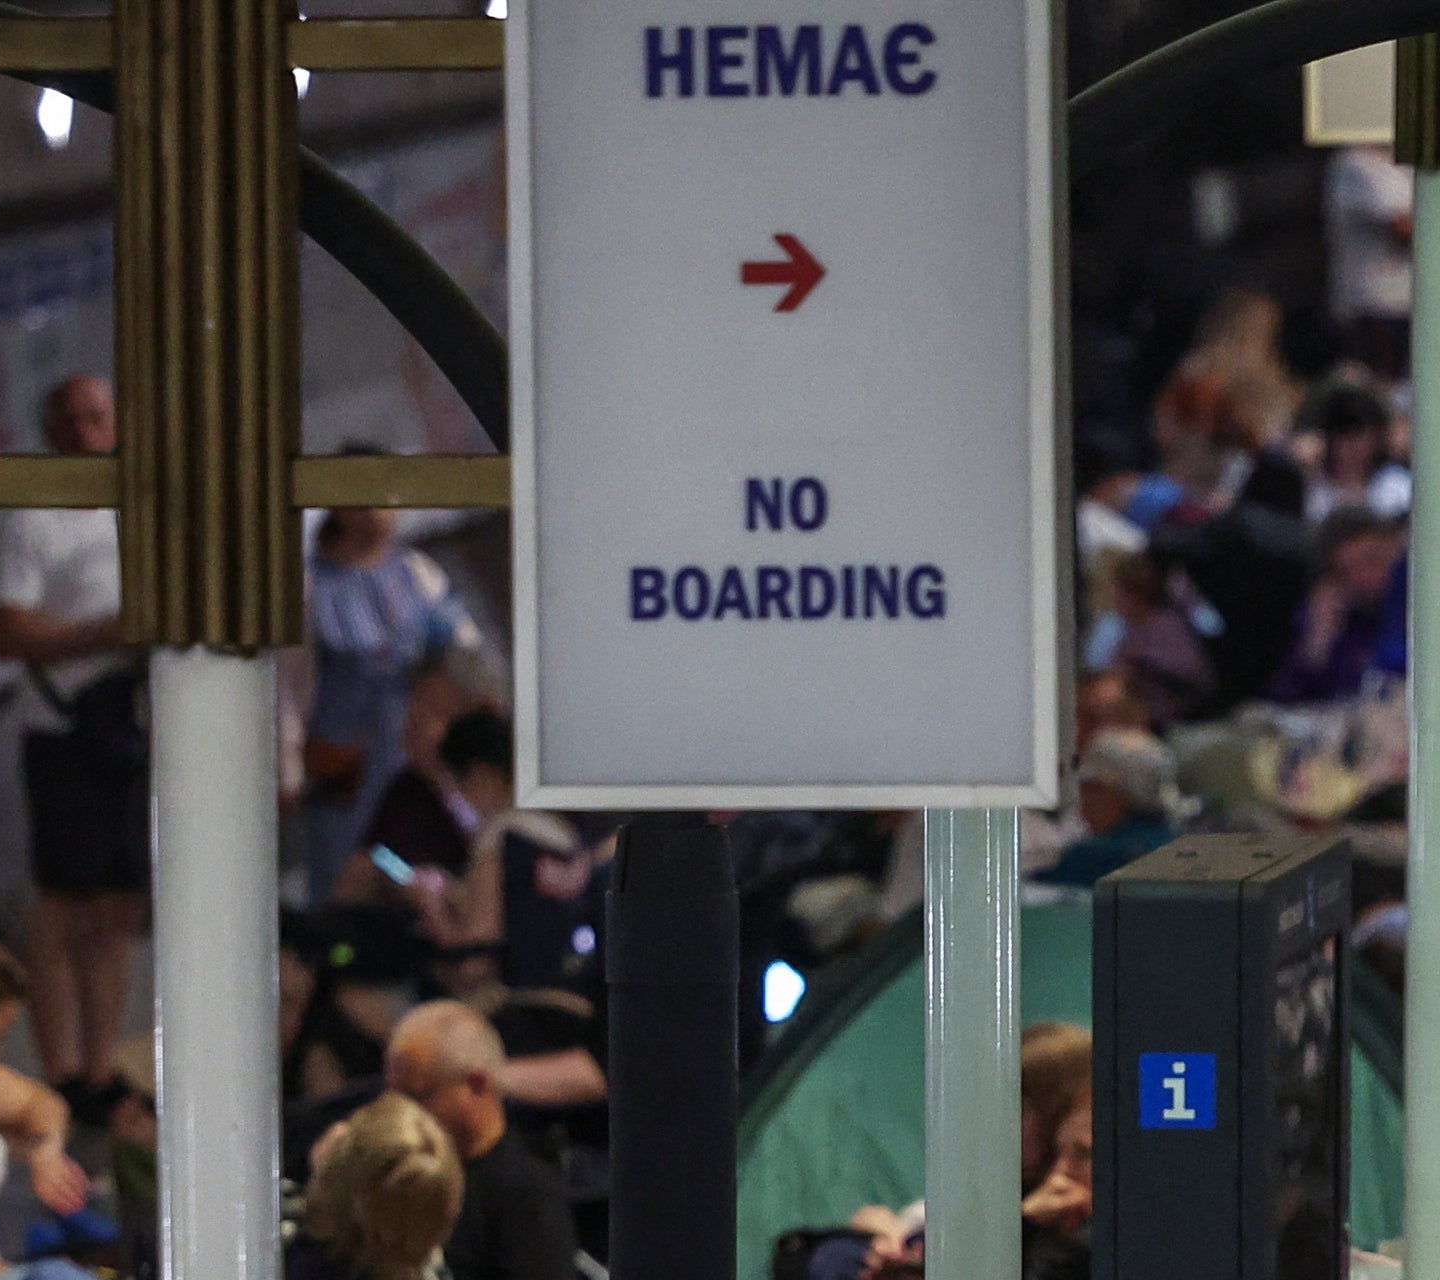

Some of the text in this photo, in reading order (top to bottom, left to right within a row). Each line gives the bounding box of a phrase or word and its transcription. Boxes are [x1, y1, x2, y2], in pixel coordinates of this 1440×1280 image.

[644, 23, 938, 98] НЕМАЄ
[745, 476, 828, 532] NO
[629, 565, 946, 622] BOARDING
